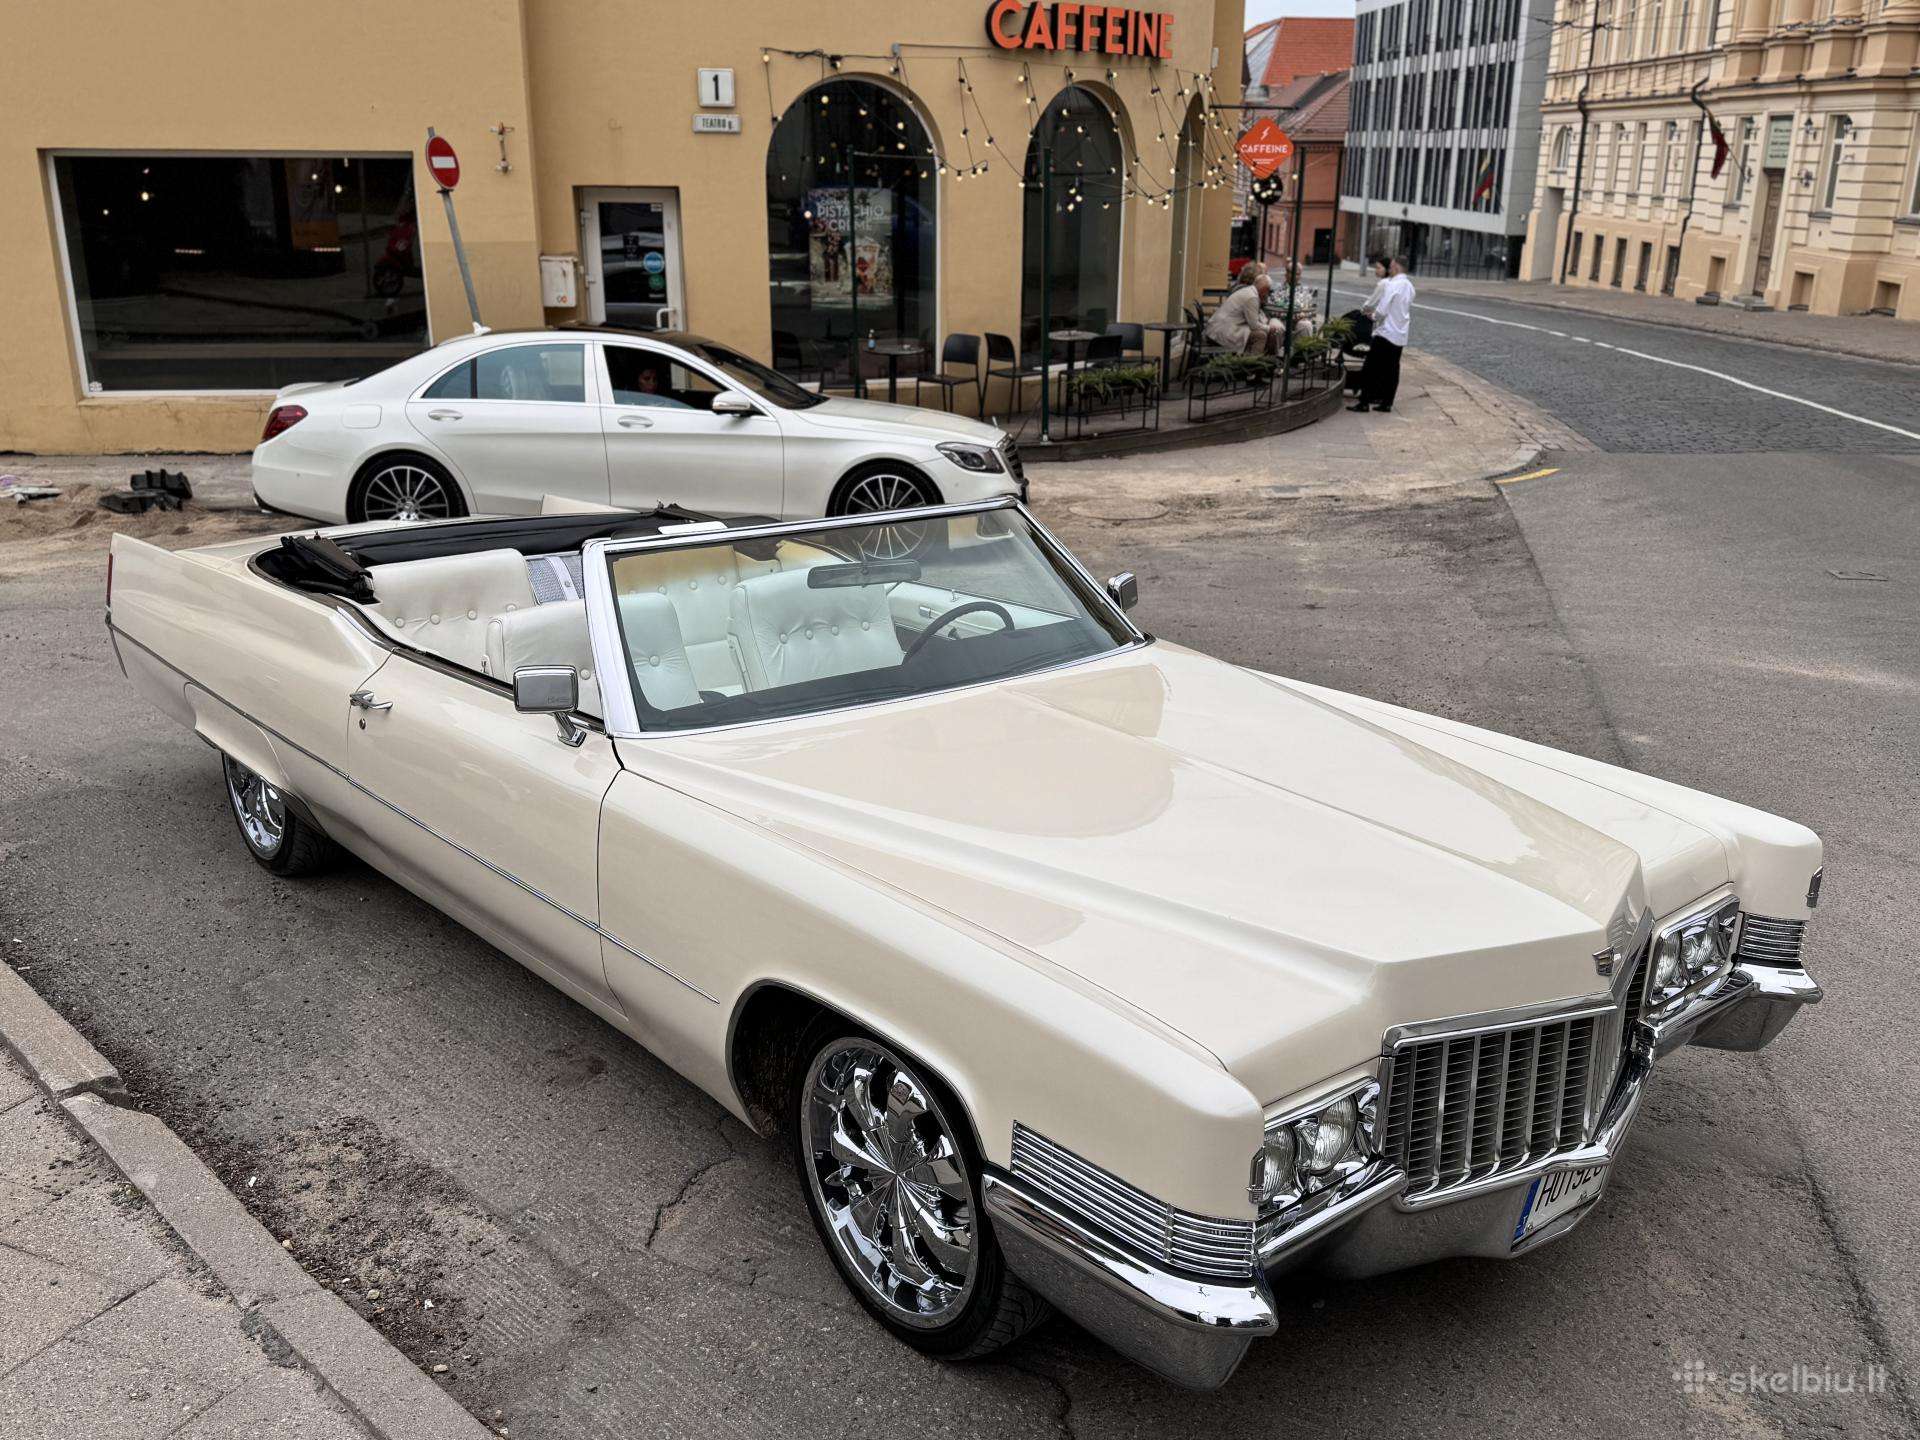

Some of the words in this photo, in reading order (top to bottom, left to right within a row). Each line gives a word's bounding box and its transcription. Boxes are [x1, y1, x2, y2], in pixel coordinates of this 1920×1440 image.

[989, 0, 1175, 59] CAFFEINE
[712, 74, 719, 101] 1
[1240, 144, 1288, 154] CAFFEINE
